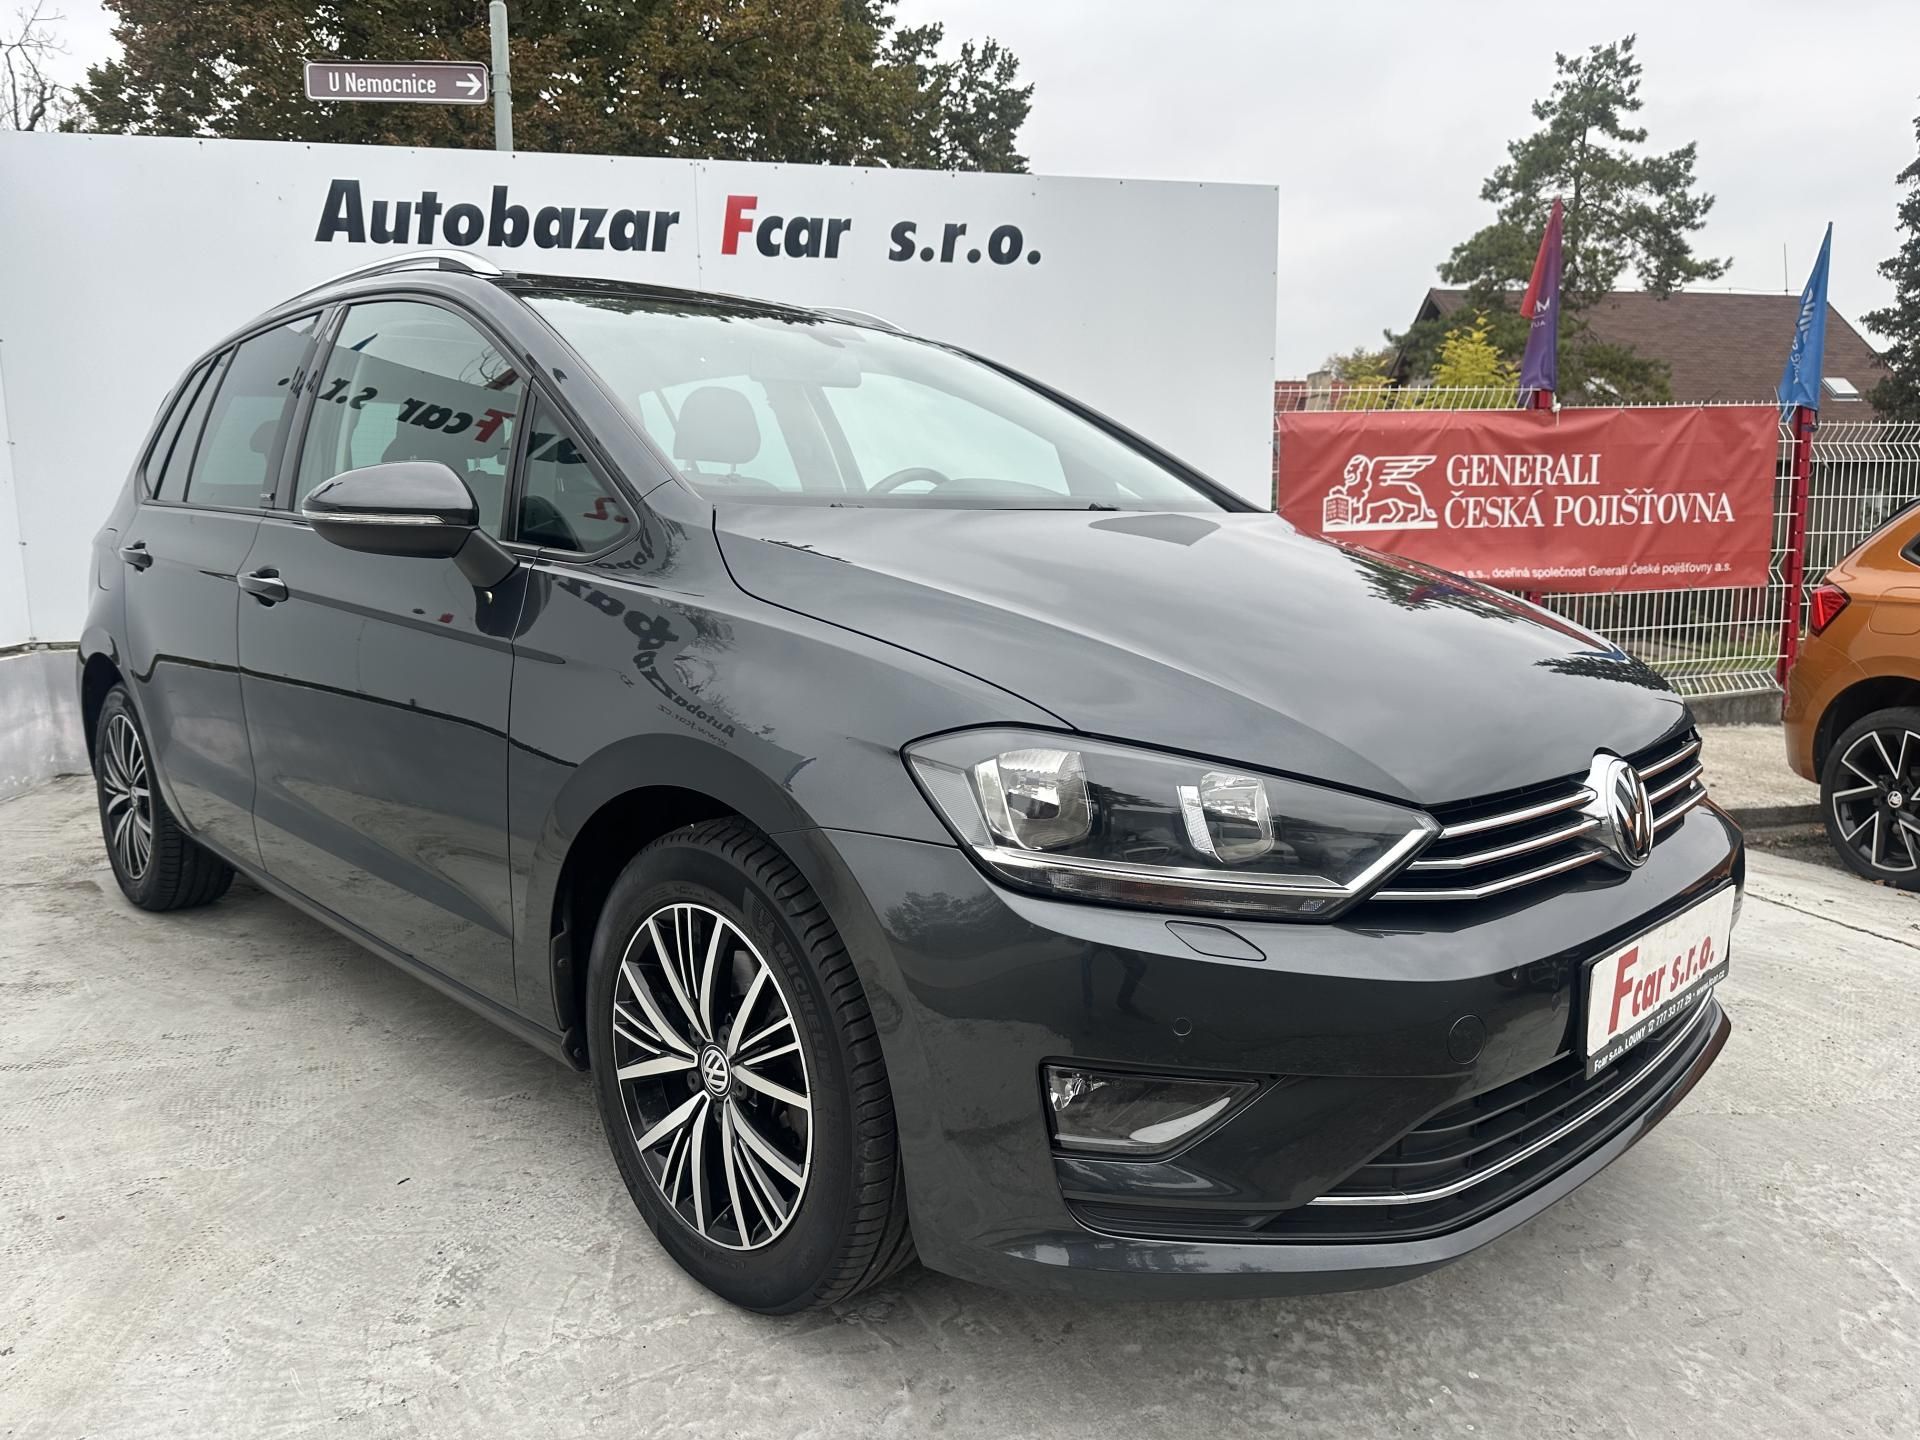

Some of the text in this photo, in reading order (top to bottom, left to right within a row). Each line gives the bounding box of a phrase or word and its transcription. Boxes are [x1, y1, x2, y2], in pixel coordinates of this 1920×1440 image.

[329, 72, 436, 94] U Nemocnice
[315, 178, 1042, 266] Autobazar Fcar s.r.o.
[1446, 453, 1601, 487] GENERALI
[1444, 487, 1735, 529] ČESKÁ POJIŠŤOVNA
[1532, 565, 1586, 580] společnost
[1588, 565, 1628, 577] Generali
[1630, 562, 1660, 575] České
[1662, 562, 1713, 576] pojišťovny
[1715, 562, 1731, 572] a.s.
[1608, 935, 1714, 1035] Fcar s.r.o.
[1594, 1053, 1608, 1072] Fcar
[1624, 1026, 1646, 1050] LOUNY
[1656, 1010, 1668, 1026] 777
